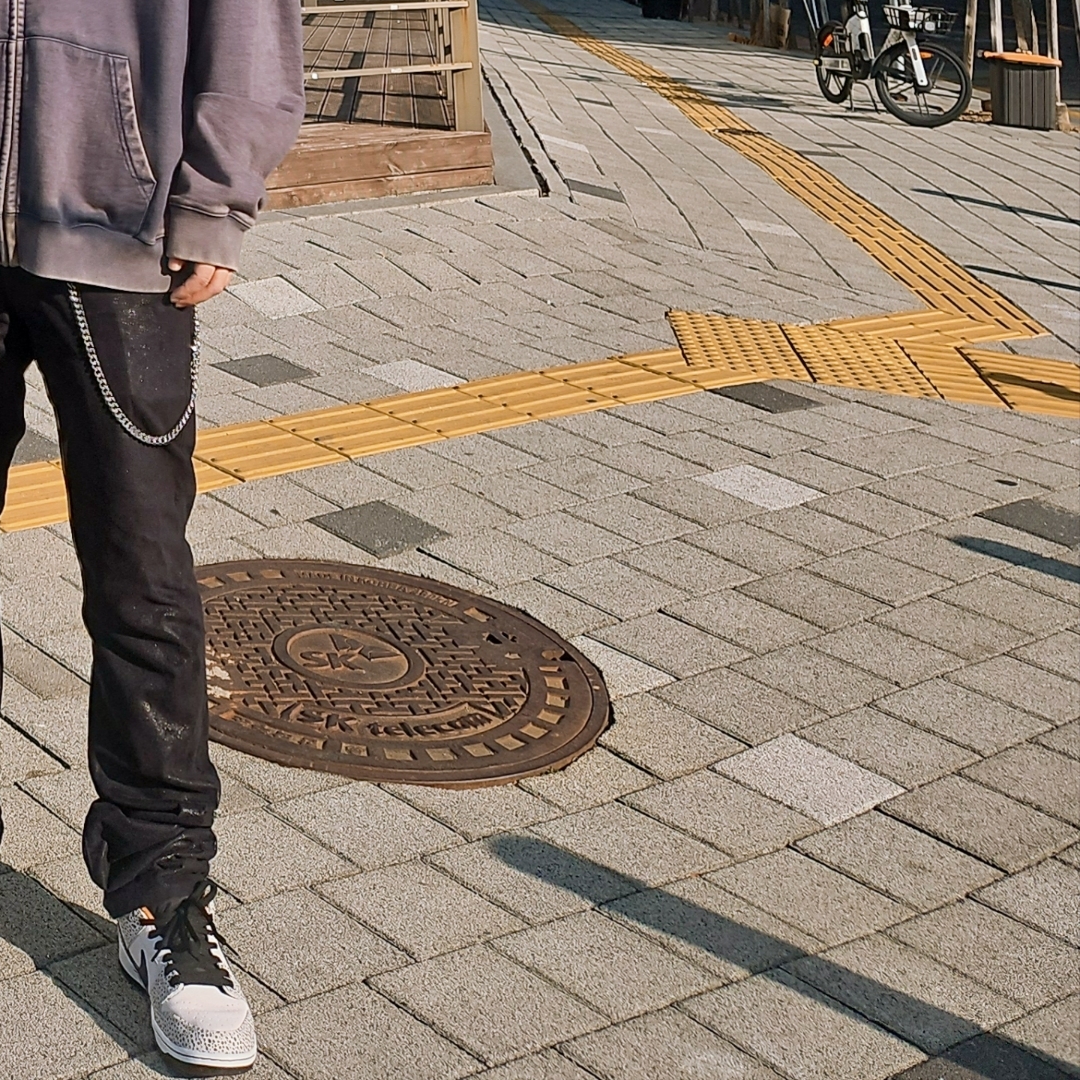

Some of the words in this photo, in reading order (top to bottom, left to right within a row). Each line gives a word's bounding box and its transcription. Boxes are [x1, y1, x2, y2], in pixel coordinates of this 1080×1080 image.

[299, 650, 364, 673] SK
[296, 709, 358, 733] SK
[369, 711, 493, 737] telecom
